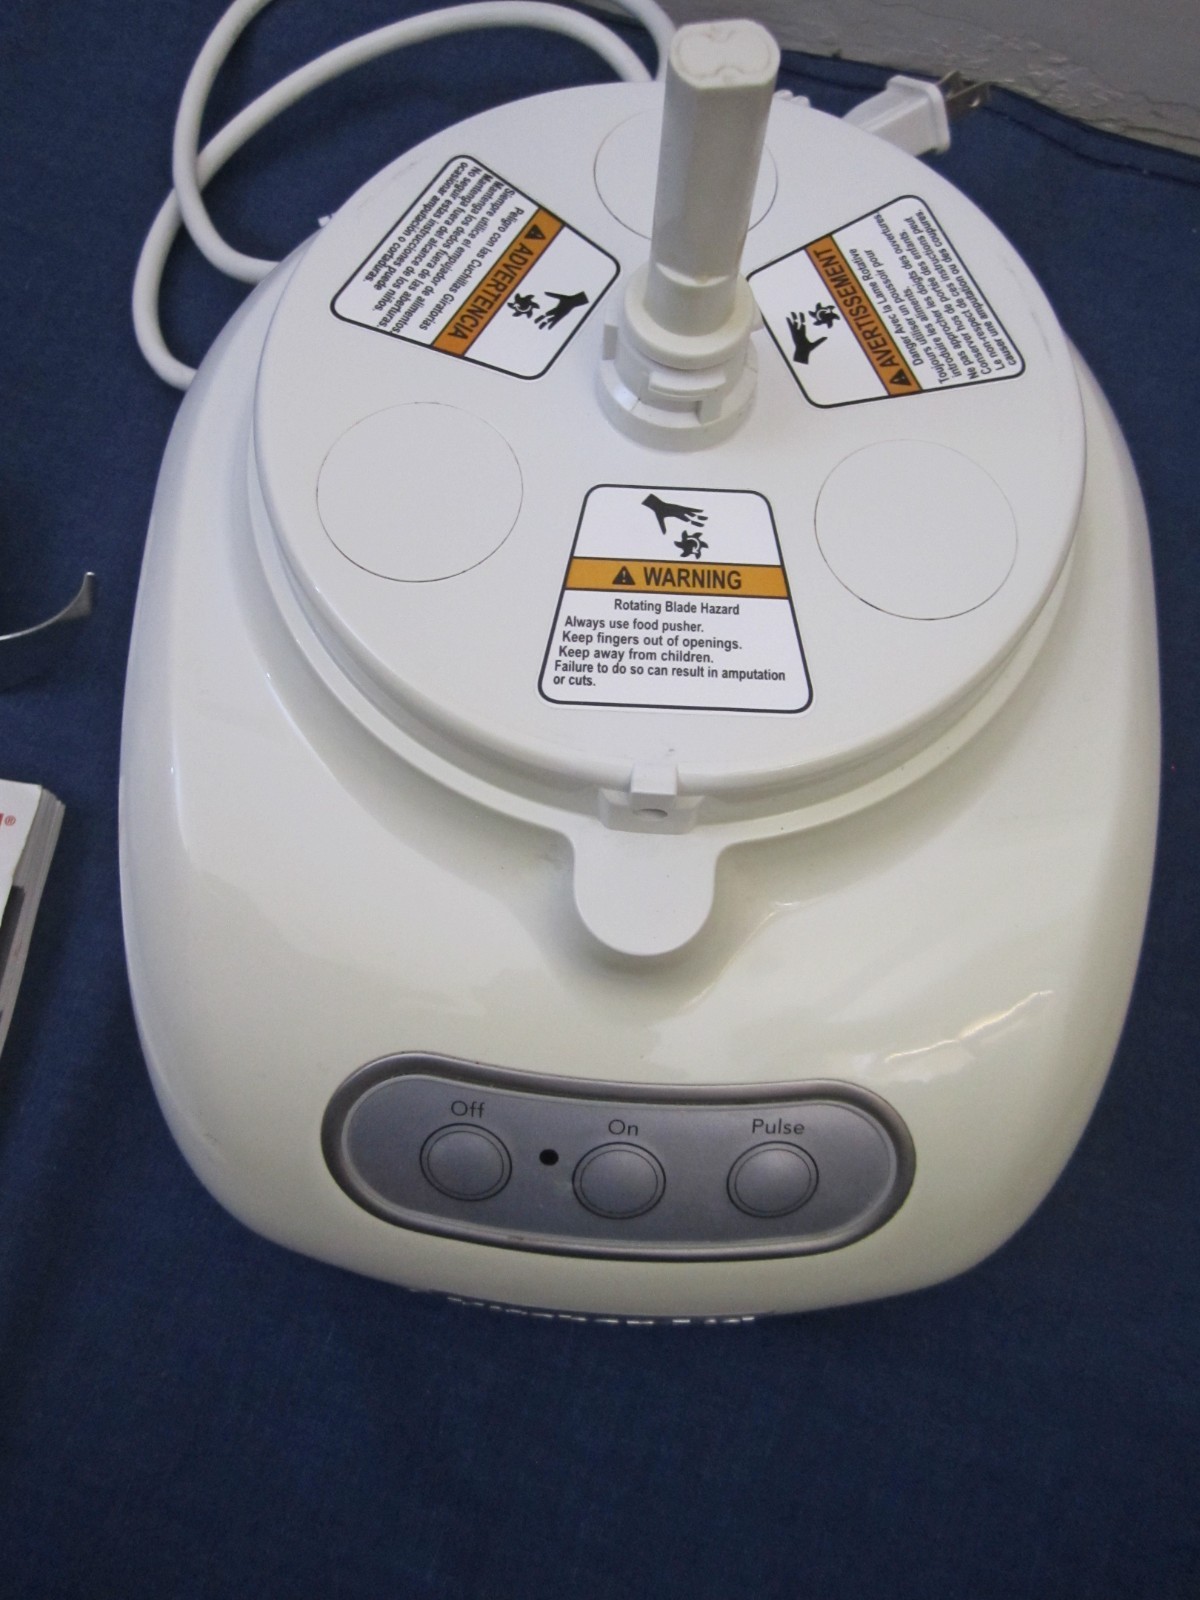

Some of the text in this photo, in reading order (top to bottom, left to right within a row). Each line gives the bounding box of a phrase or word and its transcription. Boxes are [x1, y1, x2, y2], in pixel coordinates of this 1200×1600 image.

[436, 161, 469, 197] ocasionar
[485, 187, 517, 217] Siempre
[402, 194, 441, 237] amputación
[467, 215, 490, 239] utilice
[373, 165, 483, 291] No seguir estas instrucciones puede
[397, 235, 407, 243] o
[372, 172, 495, 311] Mantenga fuera del alcance de los niños.
[460, 237, 472, 249] el
[376, 180, 506, 332] Mantenga los dedos fuera de las aberturas.
[430, 245, 466, 287] empujador
[898, 254, 913, 270] des
[917, 260, 932, 276] des
[418, 206, 525, 331] Peligro con las Cuchillas Giratorias
[420, 285, 435, 297] de
[446, 241, 535, 340] ADVERTENCIA
[903, 215, 1006, 371] Le non-respect de ces instructions peut
[907, 269, 929, 295] doigts
[915, 208, 1017, 366] causer une amputation ou des coupures.
[926, 276, 951, 303] portée
[812, 248, 900, 368] AVERTISSEMENT
[848, 248, 925, 367] Danger Avec la Lame Rotative
[923, 295, 937, 310] les
[943, 303, 956, 315] de
[863, 249, 950, 385] Toujours utiliser un poussoir pour
[902, 285, 963, 378] introduire les aliments.
[930, 309, 962, 350] approcher
[956, 349, 975, 366] pas
[960, 332, 993, 375] Conserver
[966, 366, 980, 380] Ne
[642, 566, 742, 590] WARNING
[613, 597, 740, 616] Rotating Blade Hazard
[564, 615, 704, 634] Always use food pusher.
[561, 629, 742, 652] Keep fingers out of openings.
[558, 644, 714, 664] Keep away from children.
[552, 674, 596, 687] or cuts.
[554, 659, 786, 682] Failure to do so can result in amputation
[450, 1100, 485, 1119] Off
[607, 1118, 639, 1137] On
[751, 1117, 805, 1136] Pulse
